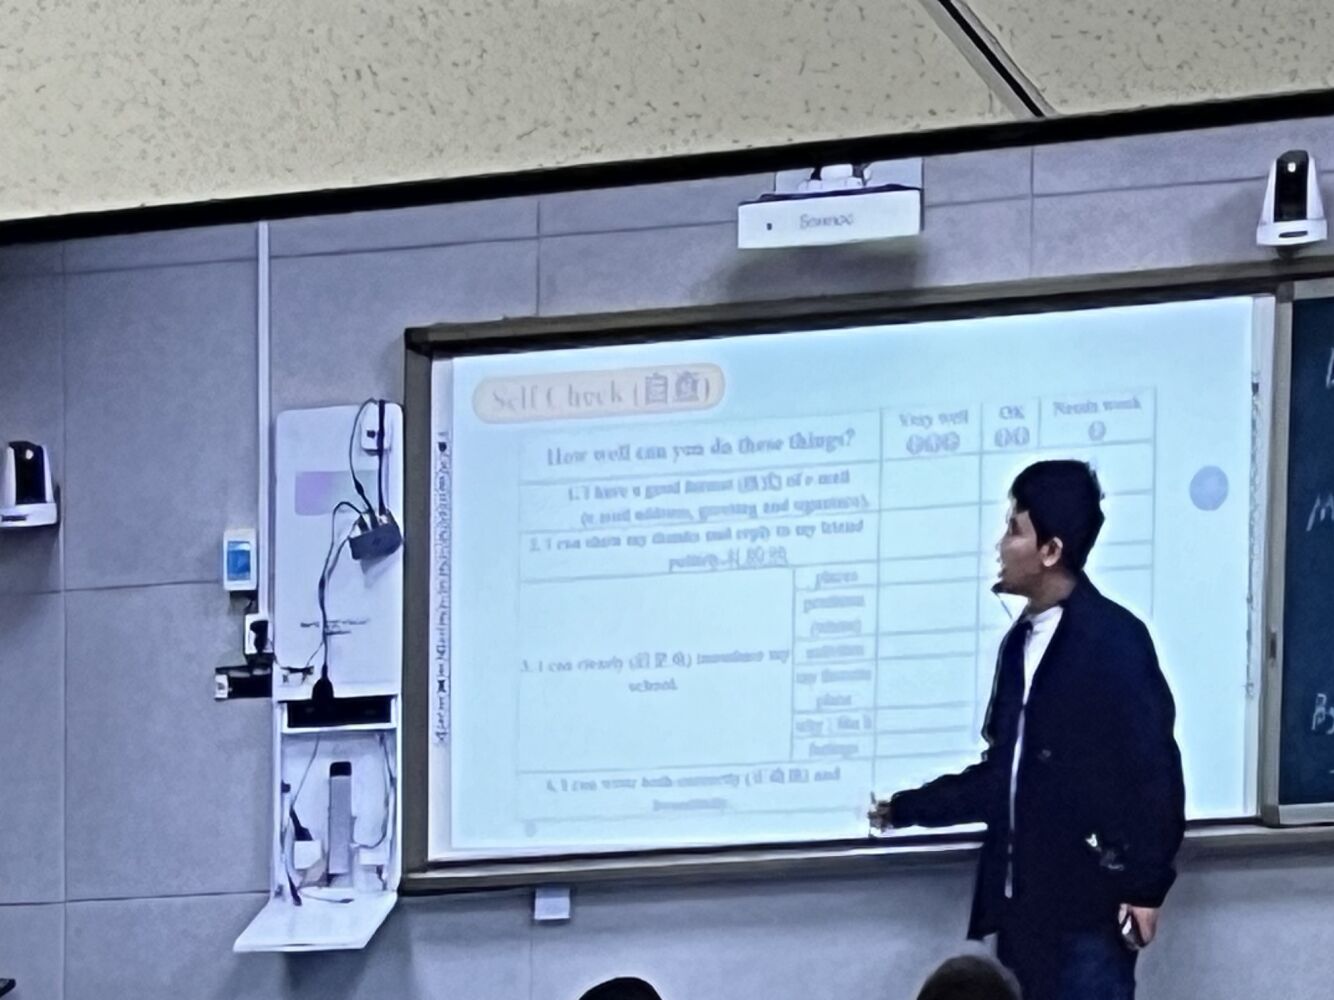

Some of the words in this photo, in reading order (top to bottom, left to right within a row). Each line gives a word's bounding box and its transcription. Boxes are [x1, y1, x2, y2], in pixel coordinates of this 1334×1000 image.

[492, 384, 538, 413] Self
[546, 379, 623, 408] Check
[999, 405, 1026, 420] OK
[547, 446, 587, 467] How
[593, 444, 632, 462] well
[636, 444, 668, 462] can
[673, 443, 705, 464] you
[710, 436, 733, 456] do
[738, 434, 784, 455] these
[789, 428, 856, 453] things?
